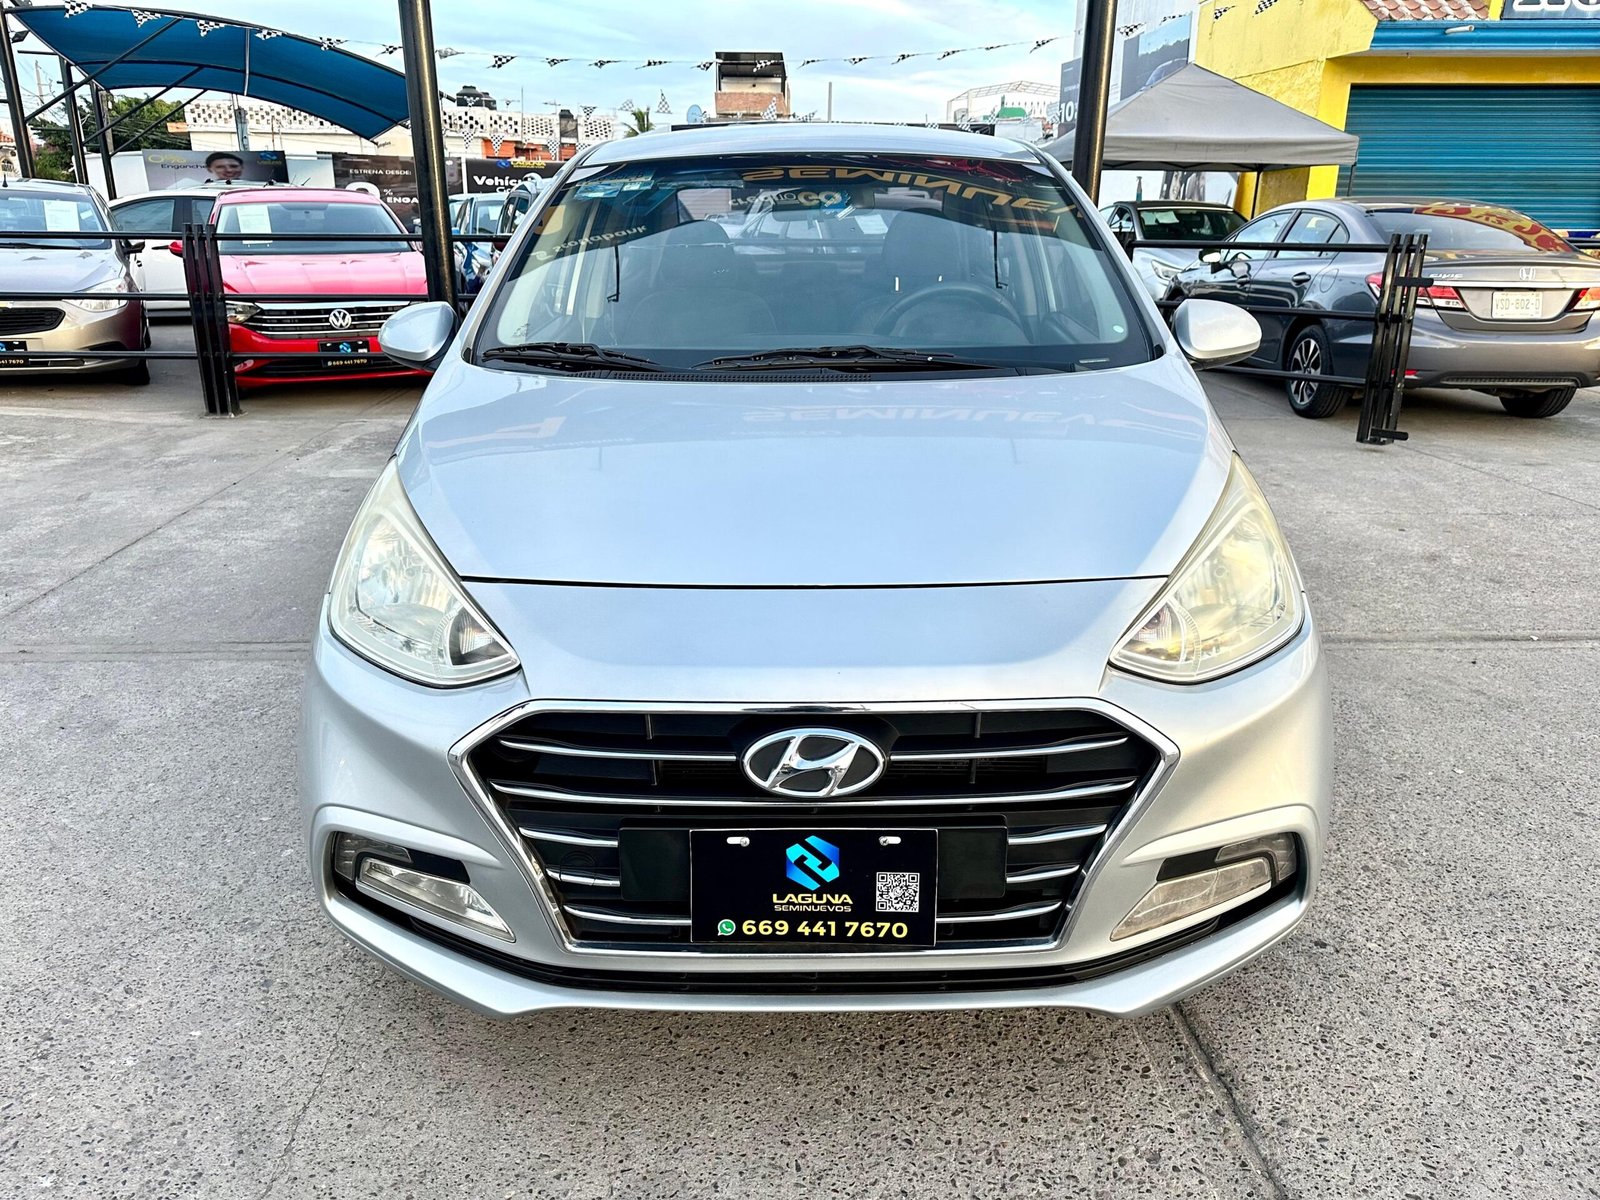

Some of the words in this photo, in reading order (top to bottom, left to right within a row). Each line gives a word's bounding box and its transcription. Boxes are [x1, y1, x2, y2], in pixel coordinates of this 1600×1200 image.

[772, 893, 853, 904] LAGUNA
[742, 920, 789, 936] 669
[797, 921, 836, 937] 441
[844, 921, 909, 938] 7670
